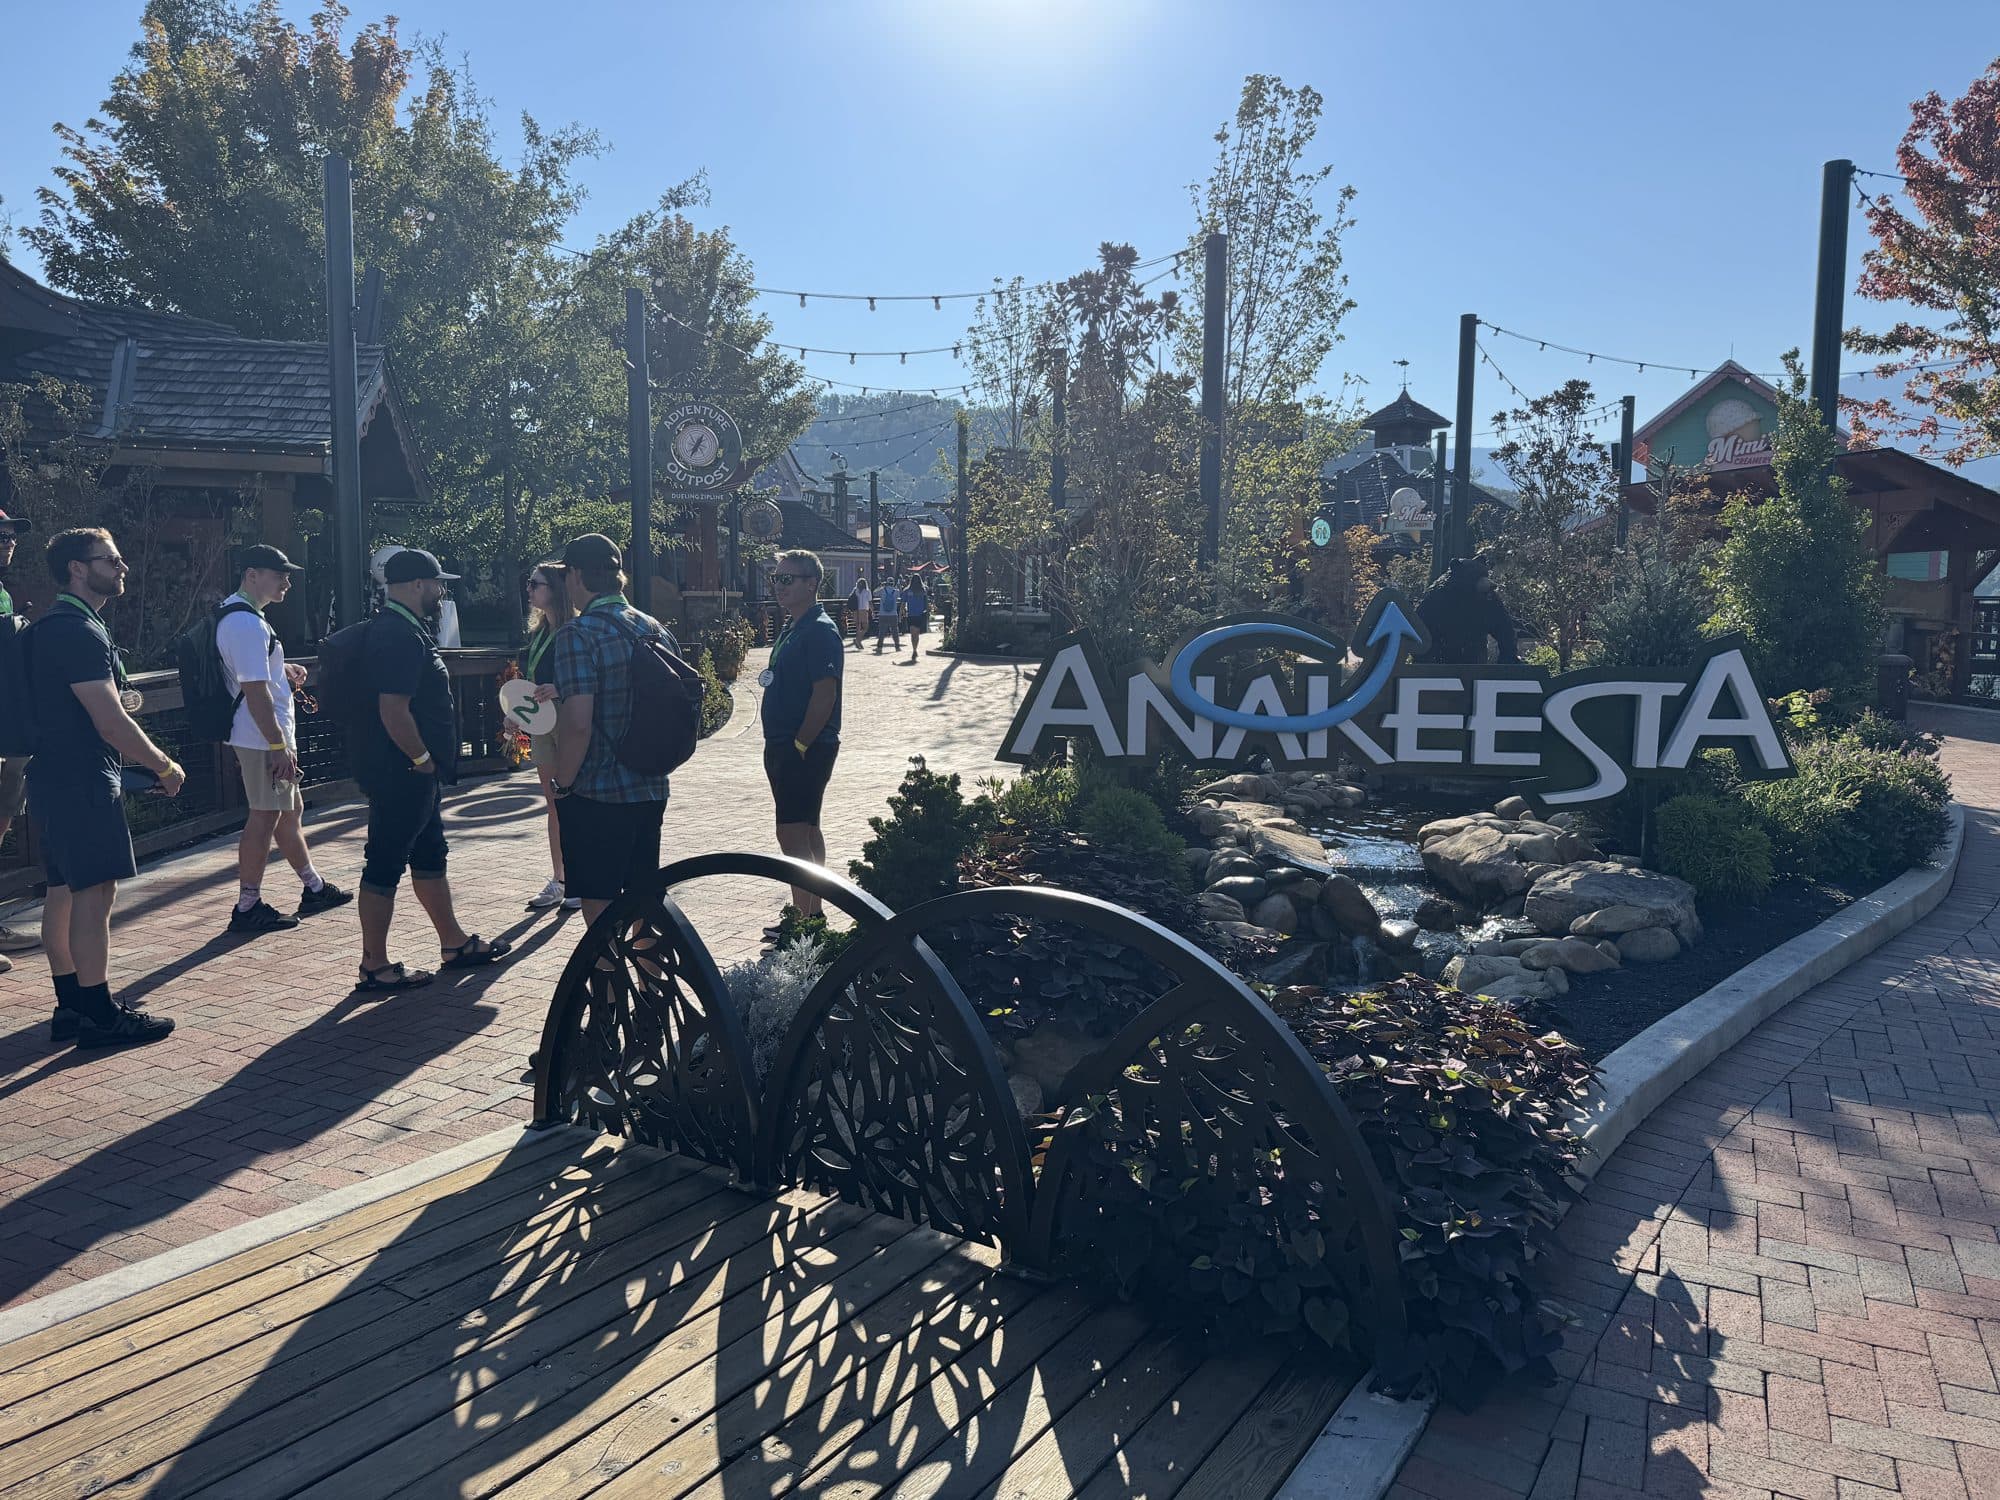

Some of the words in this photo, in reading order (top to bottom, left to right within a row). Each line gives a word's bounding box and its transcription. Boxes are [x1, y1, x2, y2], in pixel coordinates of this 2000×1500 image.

[664, 404, 731, 431] ADVENTURE
[667, 462, 730, 486] OUTPOST
[512, 695, 540, 724] 2
[1010, 642, 1790, 804] ANAKEESTA
